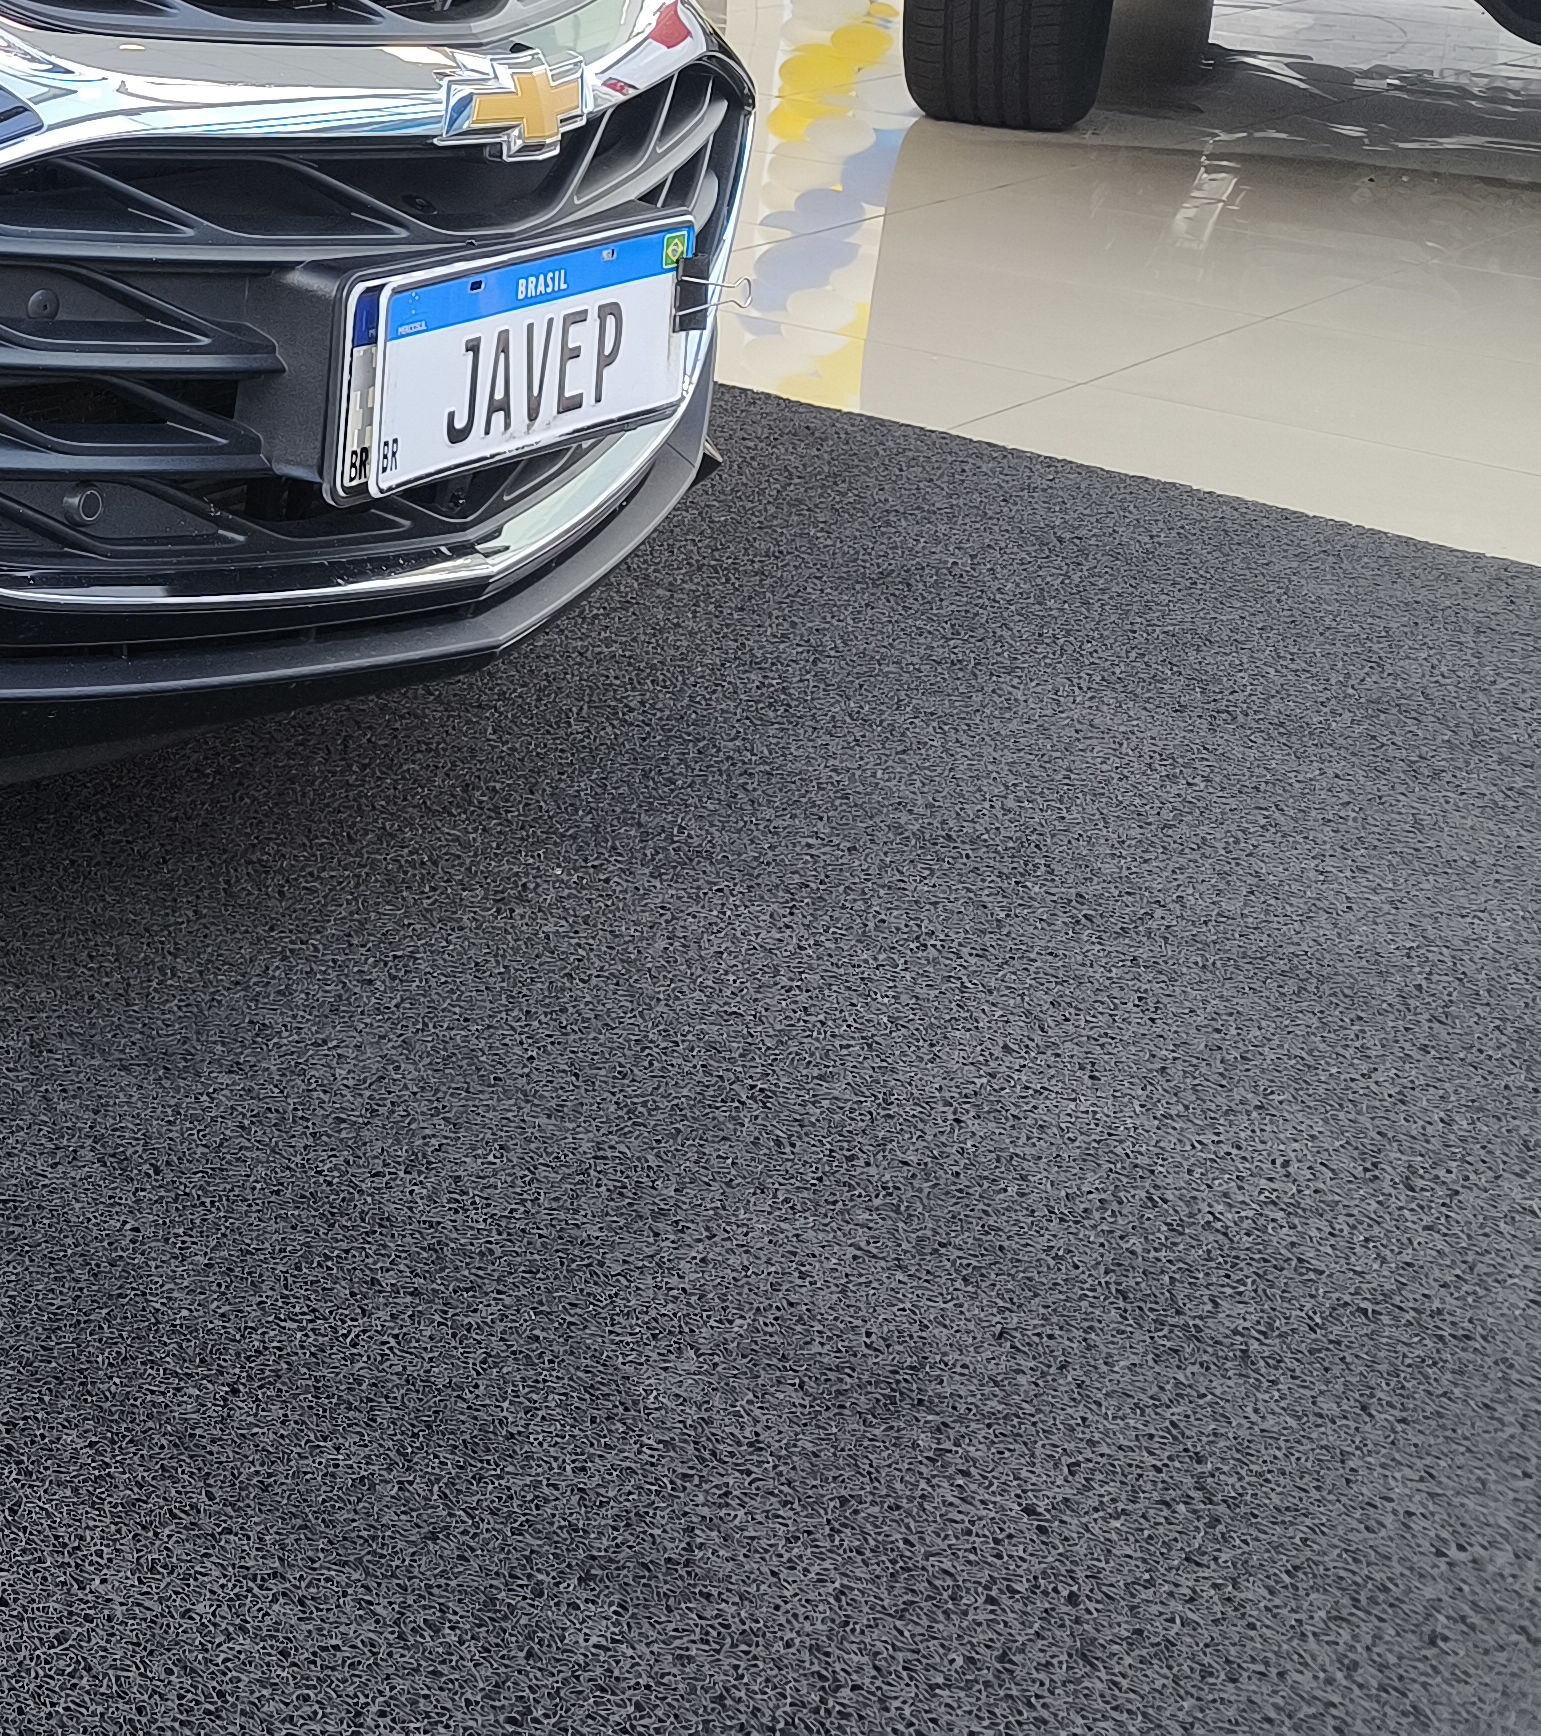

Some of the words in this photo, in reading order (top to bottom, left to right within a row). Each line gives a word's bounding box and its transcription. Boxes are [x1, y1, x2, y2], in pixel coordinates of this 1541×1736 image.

[517, 269, 568, 301] BRASIL
[446, 301, 623, 445] JAVEP
[349, 446, 369, 483] BR
[381, 437, 399, 474] BR
